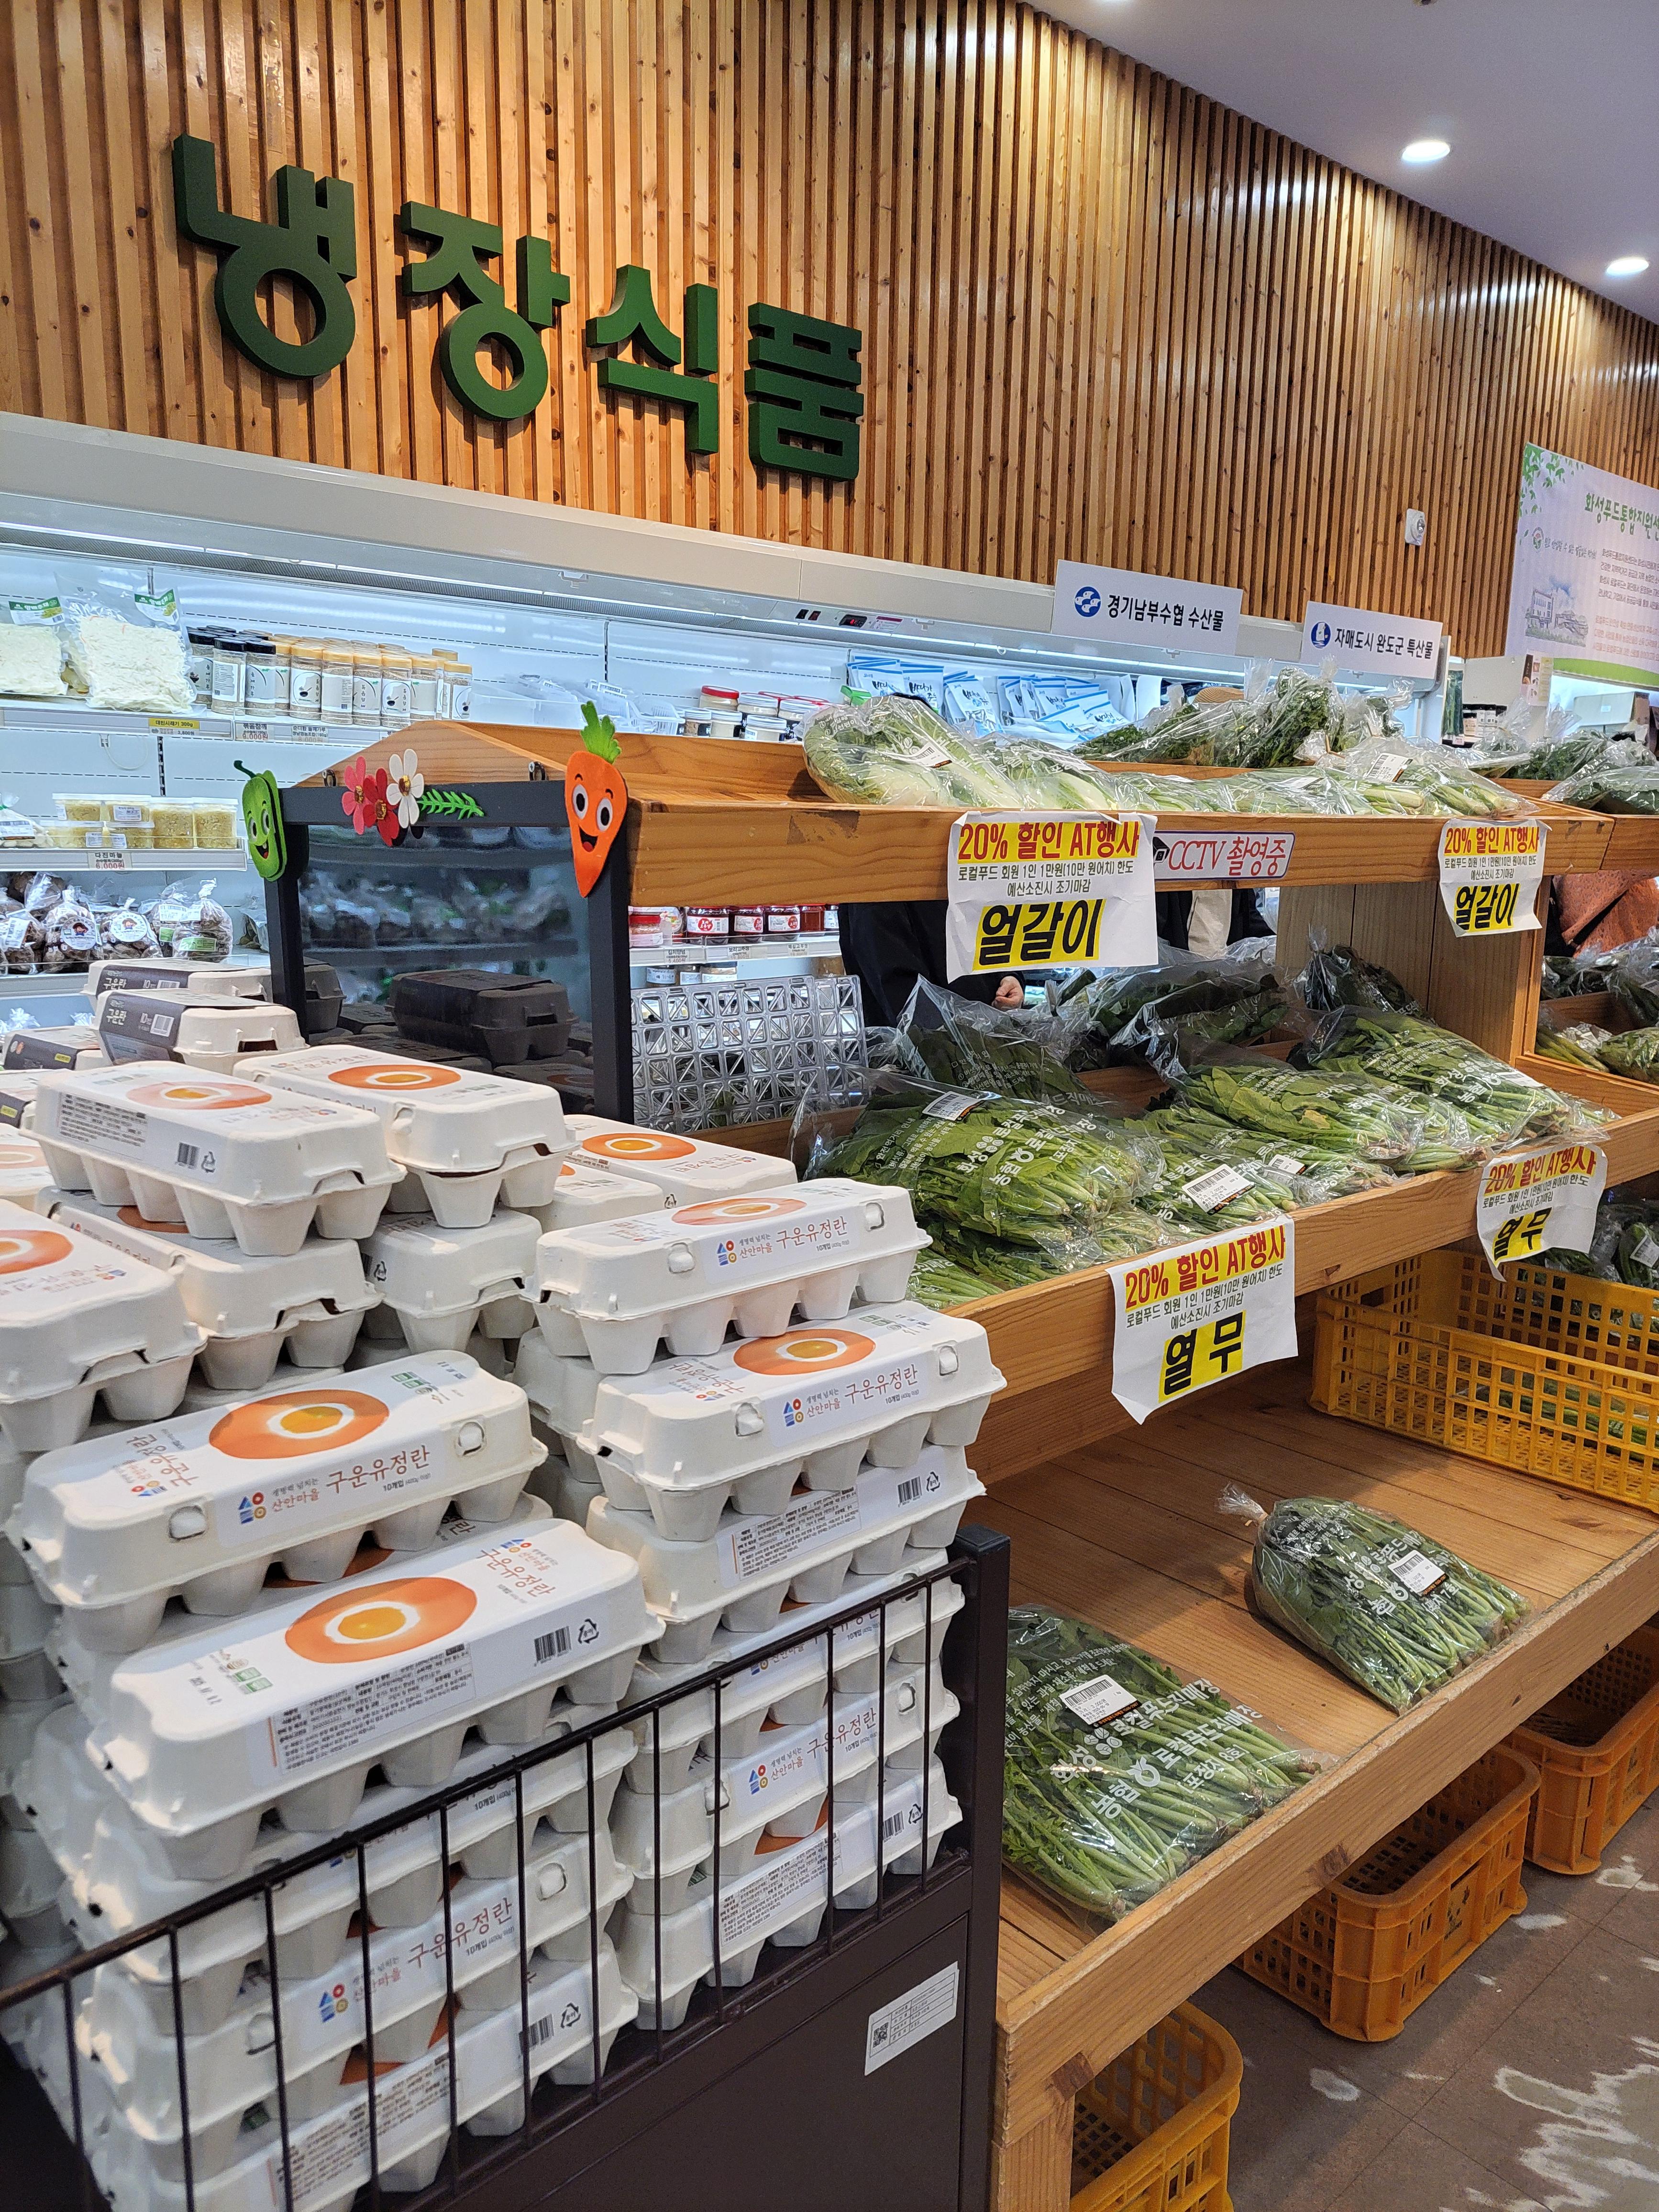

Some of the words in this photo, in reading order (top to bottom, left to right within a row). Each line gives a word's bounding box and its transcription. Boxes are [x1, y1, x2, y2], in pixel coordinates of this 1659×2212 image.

[173, 133, 862, 479] 냉장식품
[1107, 594, 1184, 628] 경기남부수협
[1187, 612, 1225, 633] 수산물
[1334, 627, 1374, 650] 자매도시
[1375, 638, 1405, 657] 완도군
[1405, 641, 1434, 660] 특산물
[959, 823, 1008, 860] 20%
[1018, 822, 1062, 860] 할인
[1073, 821, 1140, 858] AT행사
[1168, 840, 1226, 870] CCTV
[1226, 836, 1287, 877] 촬영중
[1445, 828, 1471, 853] 20%
[1476, 827, 1499, 853] 할인
[1504, 827, 1539, 853] AT행사
[958, 866, 998, 881] 로컬푸드
[1002, 864, 1020, 879] 회원
[1023, 864, 1037, 878] 1인
[1087, 862, 1115, 876] 원어치)
[1117, 861, 1133, 874] 한도
[1445, 858, 1466, 869] 로컬푸드
[1468, 857, 1477, 868] 회원
[1479, 857, 1486, 867] 1인
[1471, 869, 1494, 880] 예산소진시
[1495, 868, 1515, 879] 조기마감
[1007, 882, 1053, 897] 예산소진시
[1056, 880, 1090, 895] 조기마감
[1456, 883, 1520, 930] 얼갈이
[978, 899, 1104, 966] 얼갈이
[106, 1008, 127, 1026] 구운란
[1435, 1069, 1465, 1088] 화성
[1457, 1082, 1488, 1103] 농협
[876, 1129, 905, 1160] 안전먹거리
[901, 1117, 916, 1129] 안내
[957, 1150, 988, 1173] 화성
[989, 1162, 1023, 1186] 농협
[1484, 1162, 1517, 1194] 20%
[1520, 1155, 1547, 1187] 할인
[1545, 1146, 1596, 1177] AT행사
[1482, 1194, 1506, 1209] 로컬푸드
[1507, 1191, 1520, 1204] 회원
[1570, 1174, 1589, 1186] 한도
[1509, 1199, 1534, 1215] 예산소진시
[776, 1216, 847, 1249] 구운유정란
[1493, 1215, 1524, 1261] 열
[1521, 1206, 1553, 1250] 무
[740, 1242, 773, 1259] 산안마을
[1126, 1262, 1169, 1309] 20%
[1177, 1246, 1219, 1292] 할인
[1226, 1225, 1286, 1277] AT행사
[1127, 1304, 1161, 1328] 로컬푸드
[1163, 1297, 1181, 1316] 회원
[1184, 1292, 1198, 1308] 1인
[1241, 1273, 1267, 1289] 원어치)
[1268, 1263, 1283, 1280] 한도
[1171, 1304, 1211, 1330] 예산소진시
[1213, 1292, 1244, 1316] 조기마감
[1164, 1328, 1198, 1396] 열
[1209, 1311, 1243, 1374] 무
[844, 1364, 918, 1404] 구운유정란
[807, 1397, 841, 1417] 산안마을
[326, 1445, 430, 1493] 구운유정란
[272, 1488, 320, 1512] 산안마을
[476, 1548, 556, 1597] 구운유정란
[1011, 1675, 1043, 1697] 섭취하지
[1014, 1707, 1025, 1717] 수
[1021, 1695, 1041, 1712] 있는
[1050, 1744, 1097, 1784] 화성
[1109, 1677, 1220, 1736] 로컬푸드직매장
[770, 1756, 804, 1782] 산안마을
[1091, 1779, 1141, 1819] 농협
[408, 1897, 513, 1969] 구운유정란
